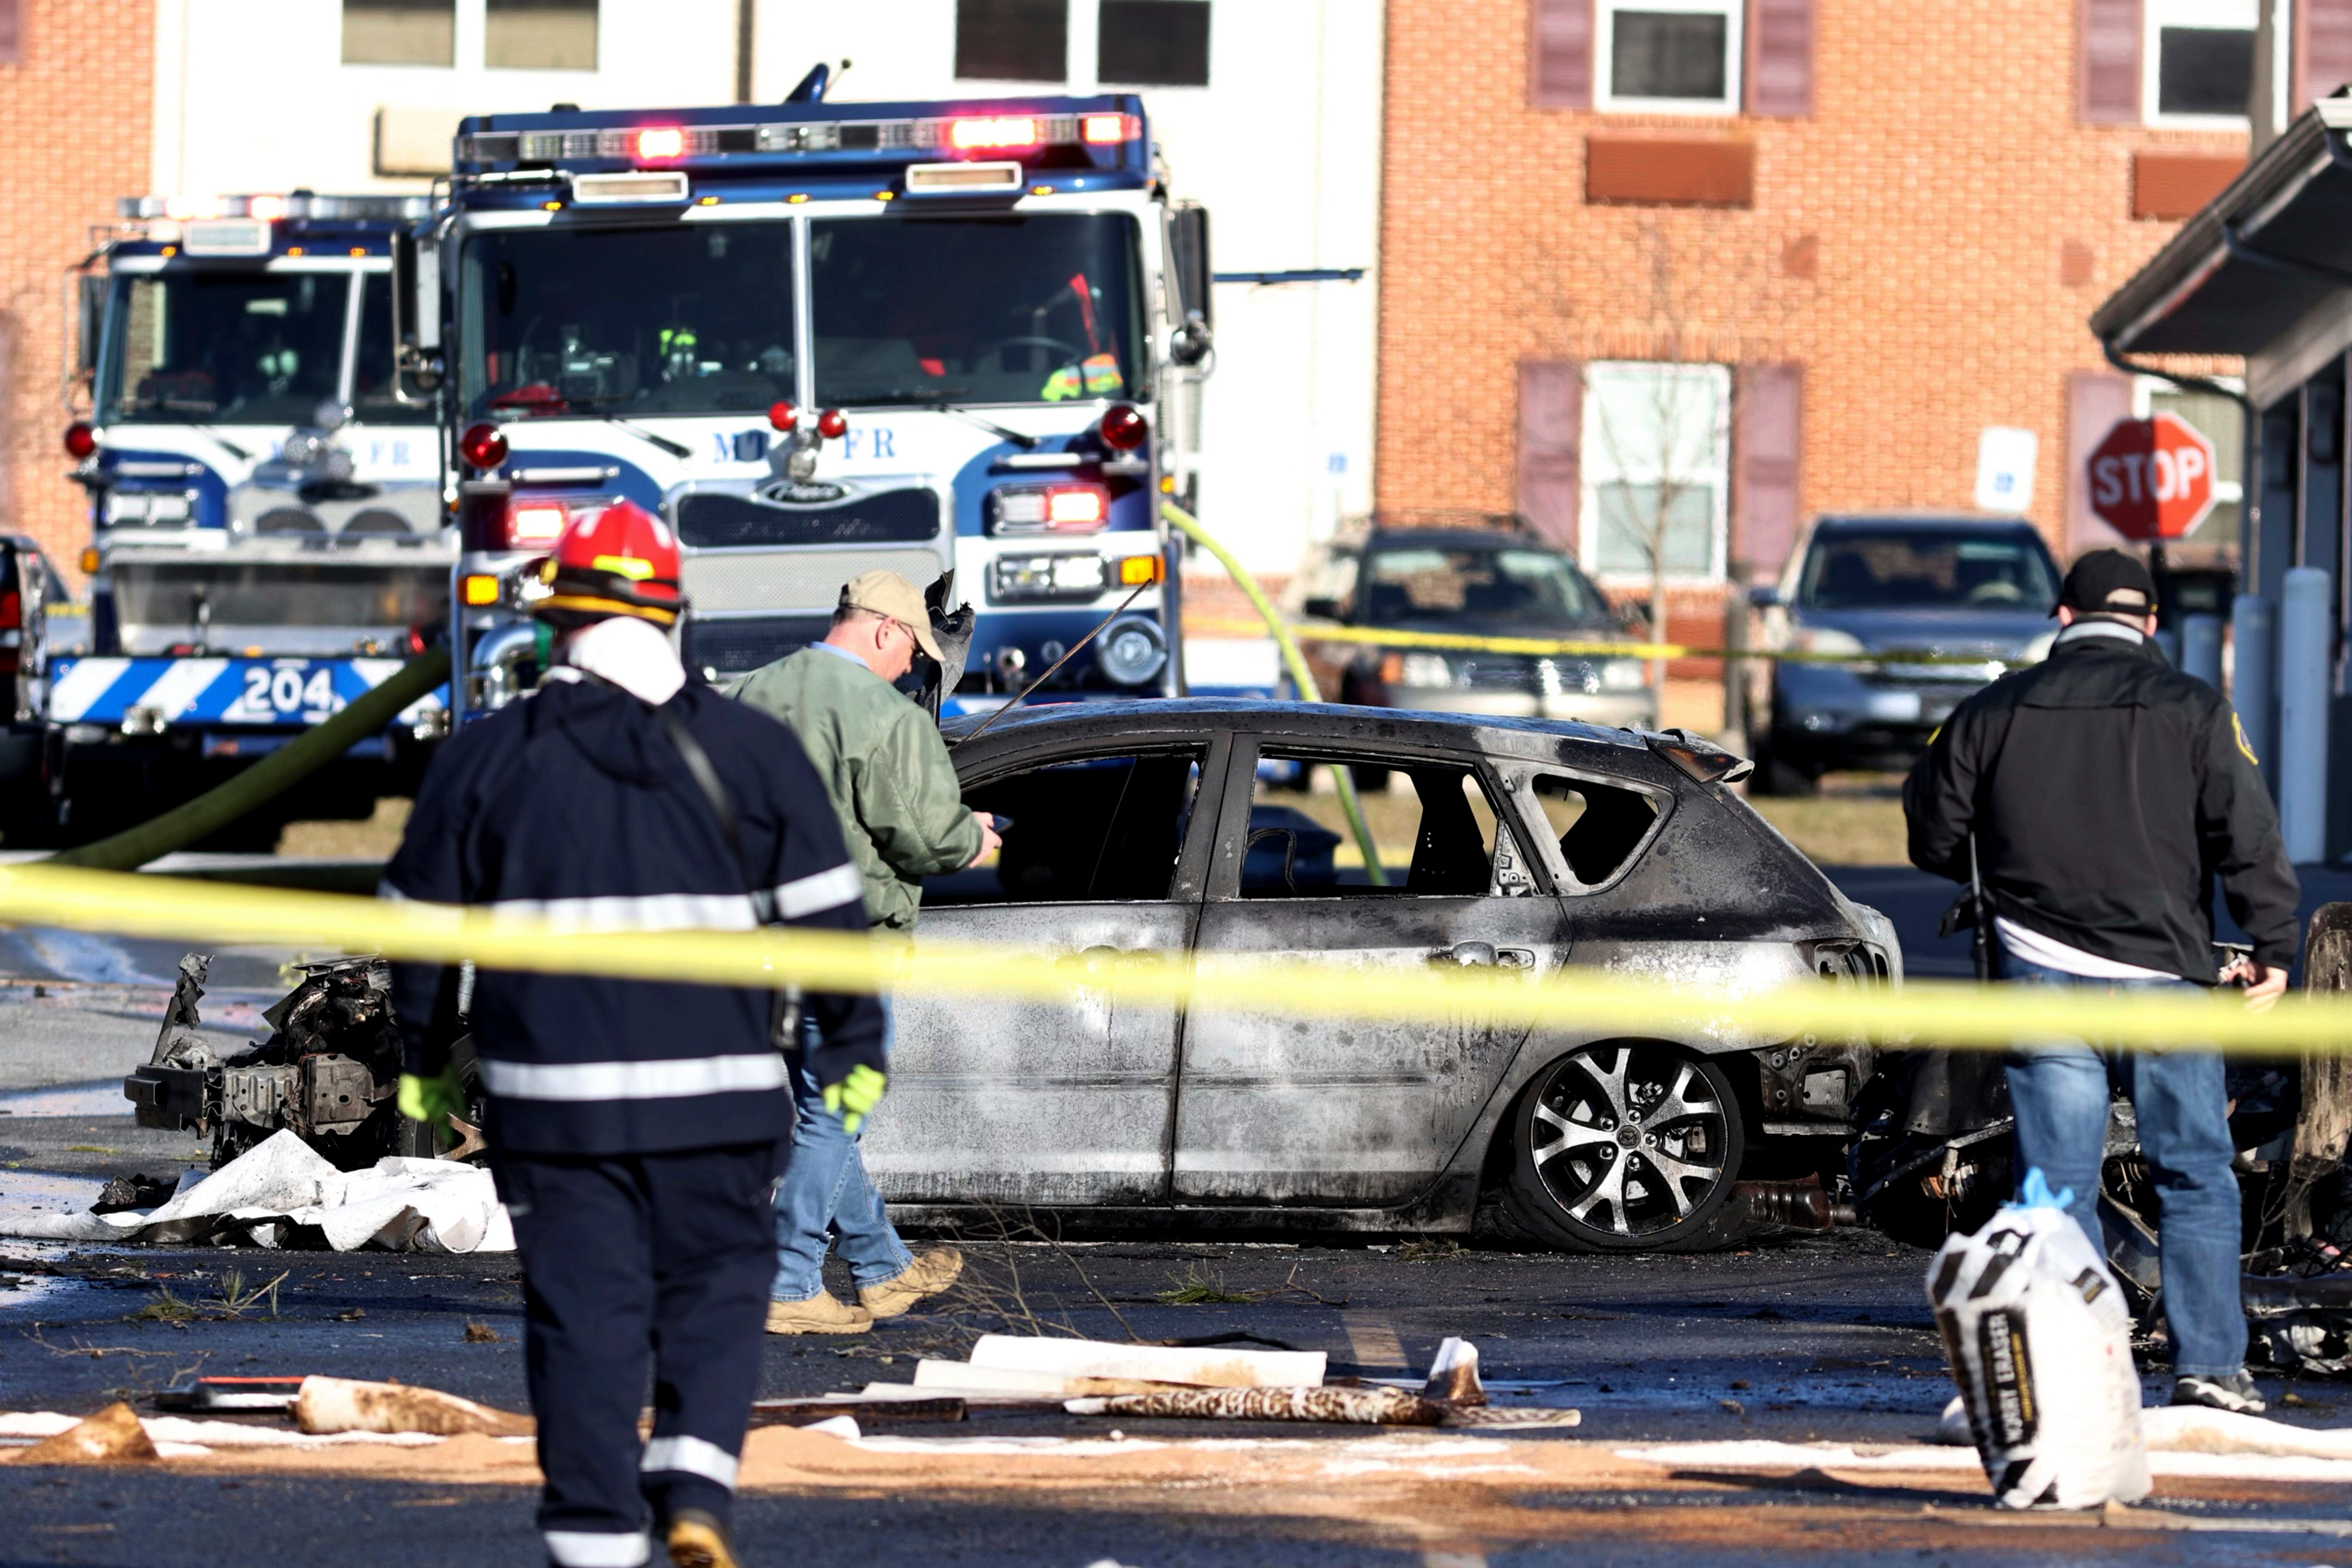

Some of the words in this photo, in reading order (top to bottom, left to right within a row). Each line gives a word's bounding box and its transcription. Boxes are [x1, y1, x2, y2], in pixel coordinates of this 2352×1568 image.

[2095, 447, 2205, 504] STOP
[244, 666, 334, 713] 204
[1988, 1313, 2015, 1383] ERASER
